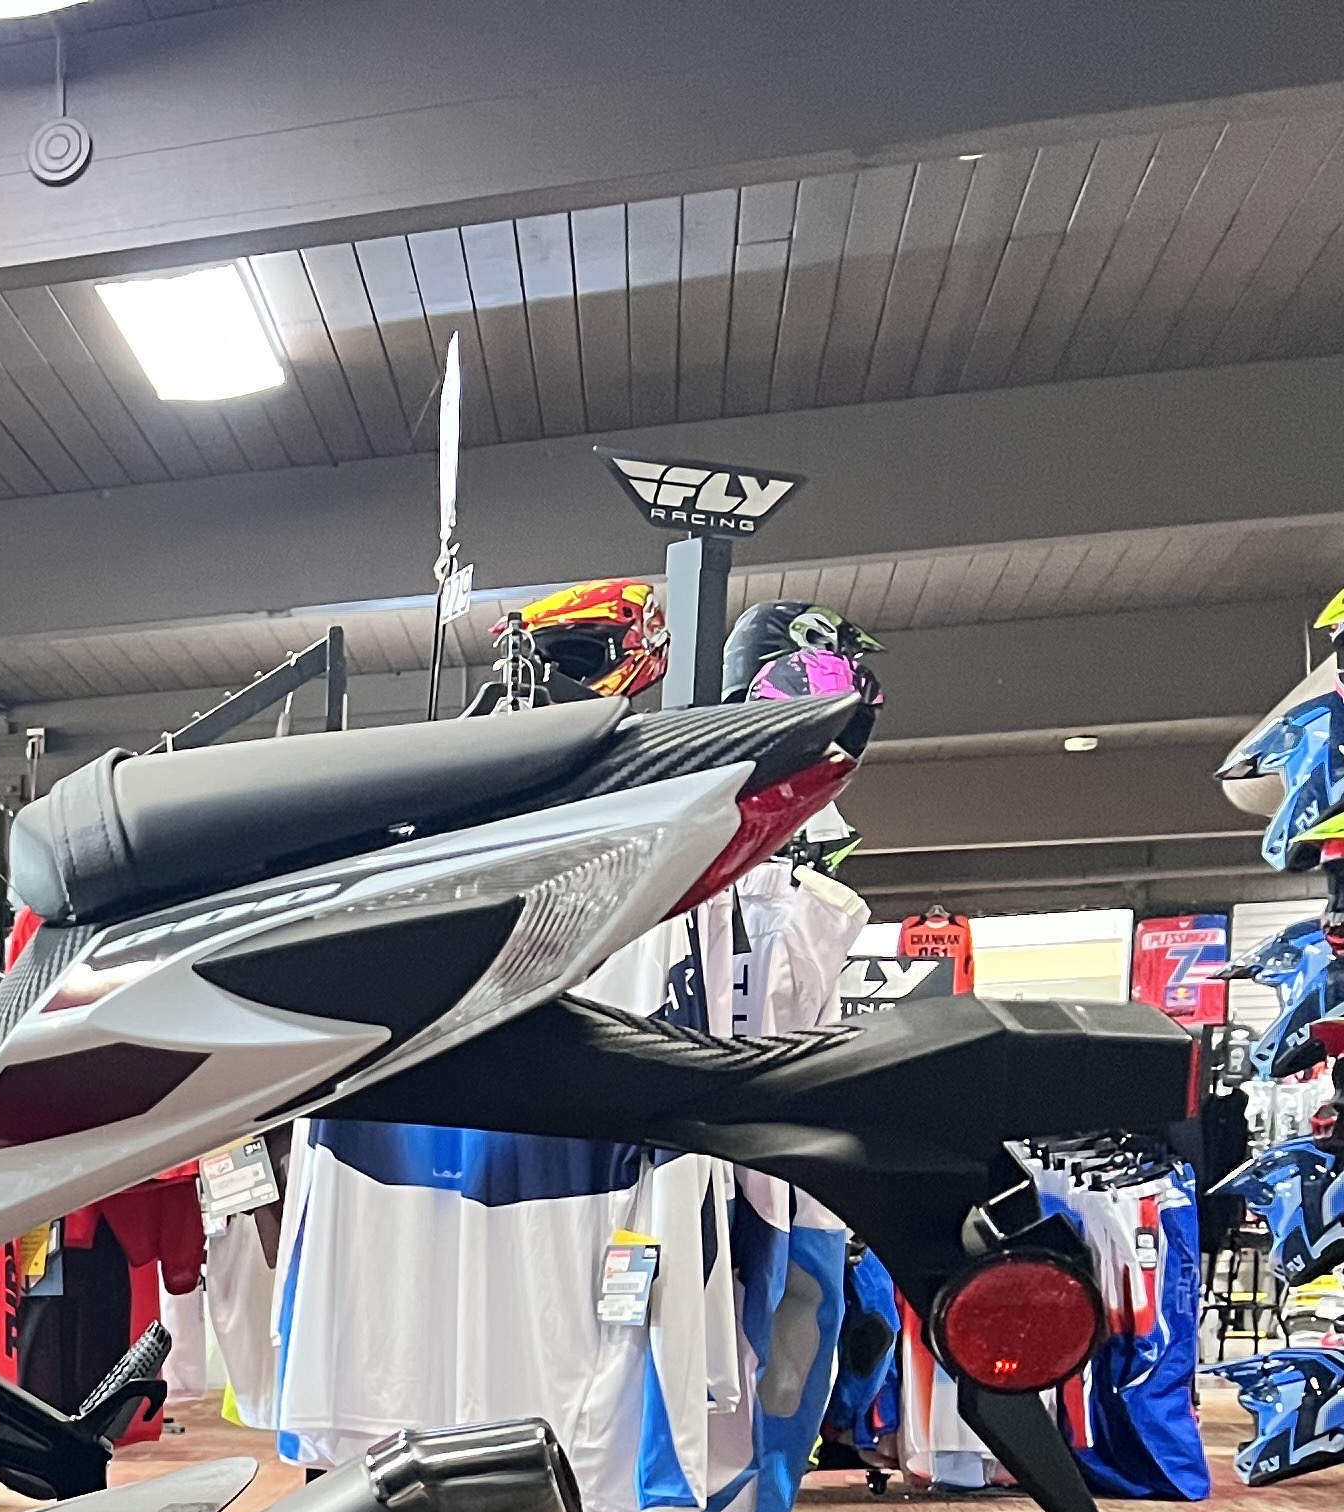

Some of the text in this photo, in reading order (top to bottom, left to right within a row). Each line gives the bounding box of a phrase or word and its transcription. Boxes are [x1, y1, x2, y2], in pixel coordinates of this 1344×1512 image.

[612, 457, 794, 517] FLY
[650, 507, 755, 531] RACING
[838, 959, 940, 1000] LY
